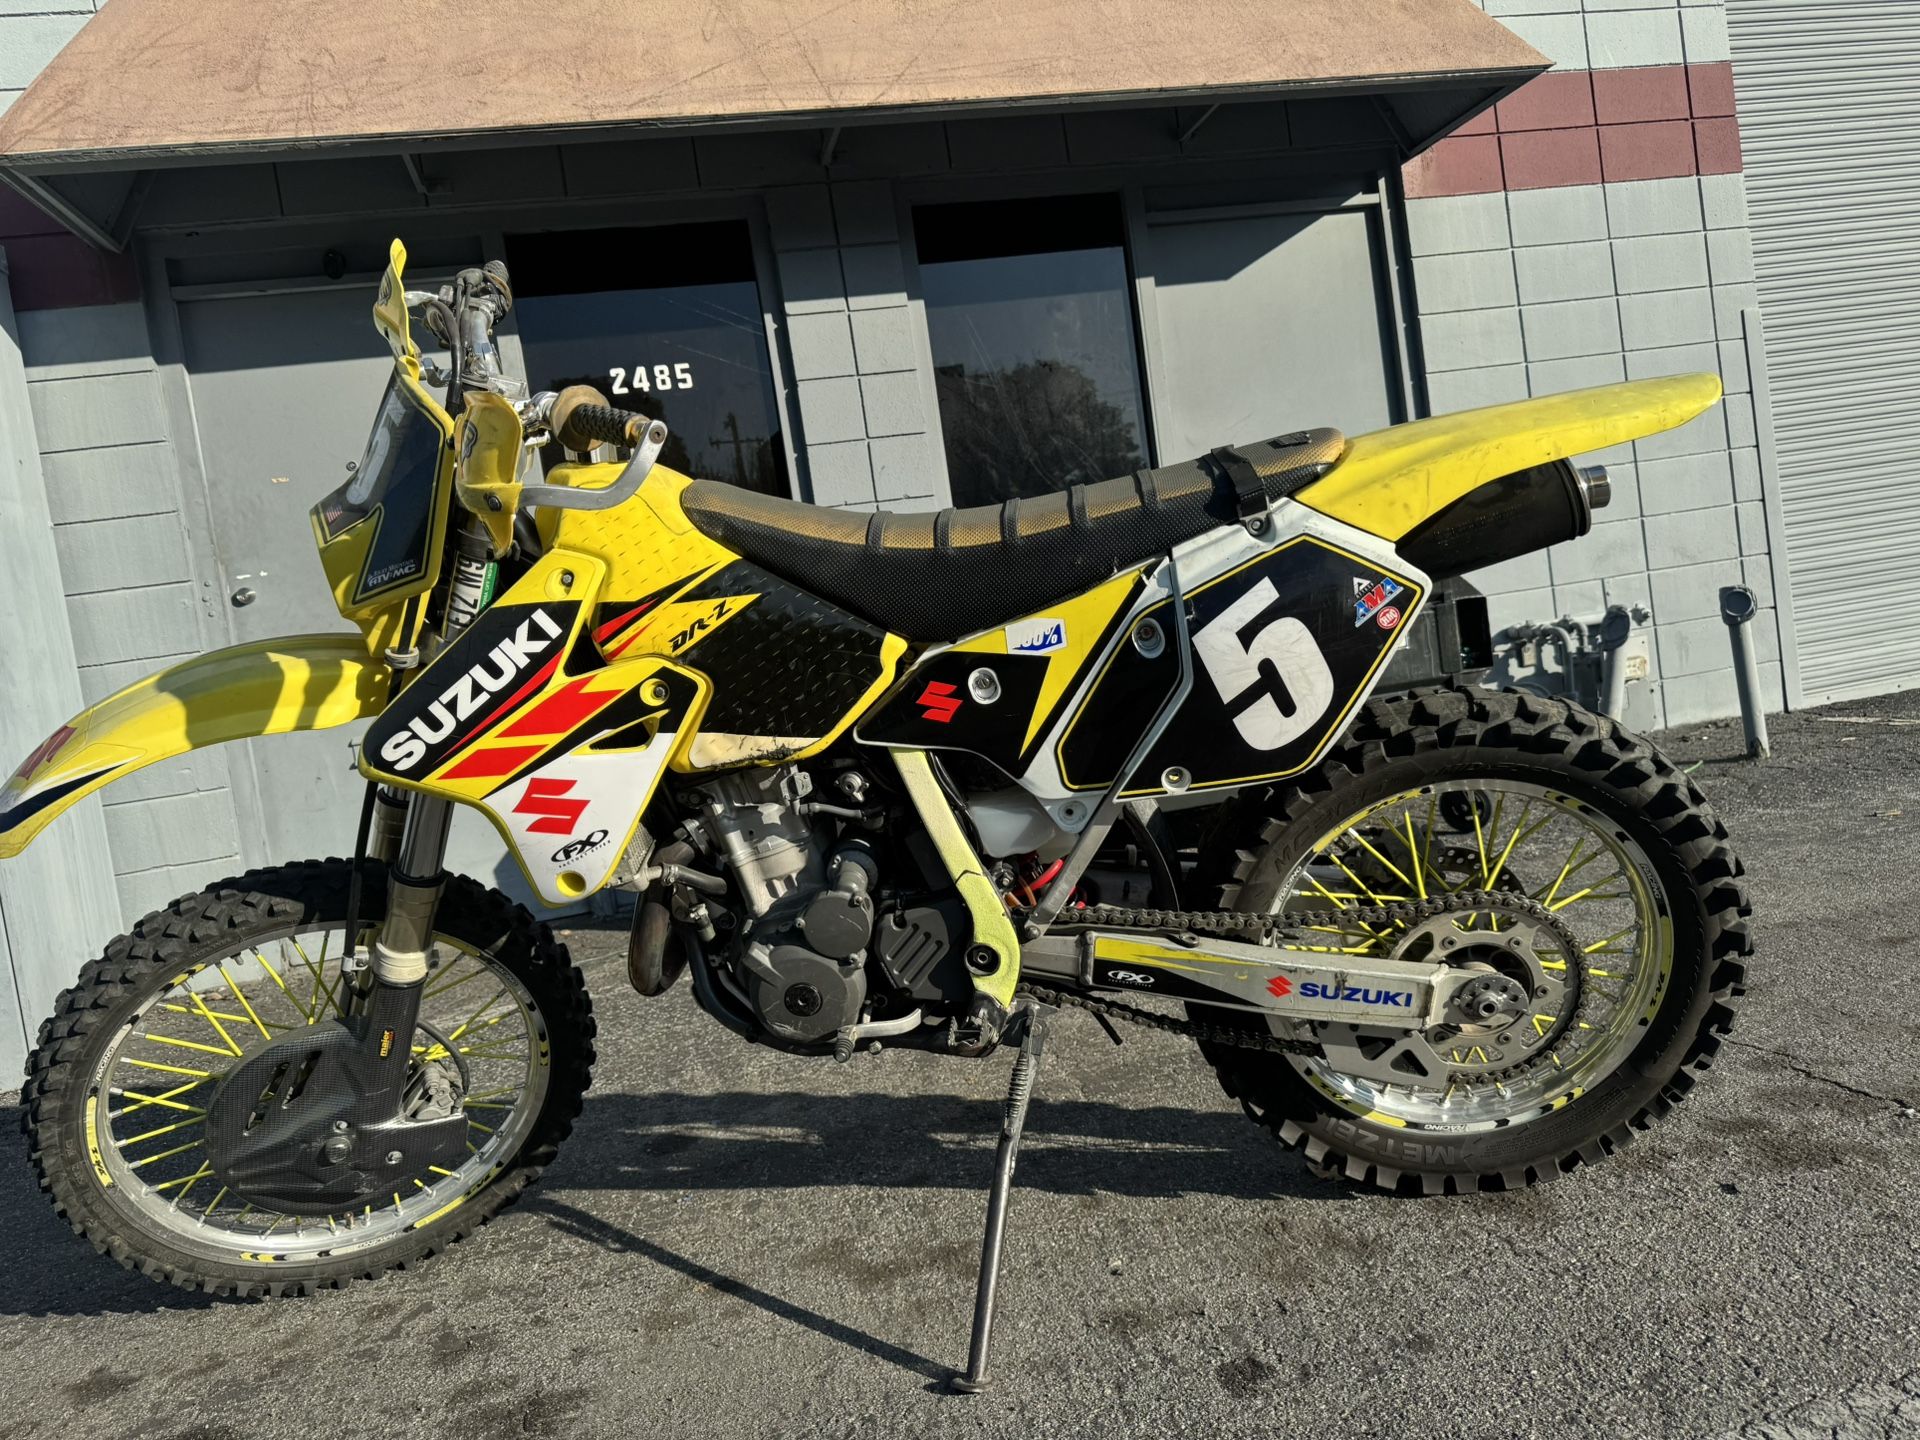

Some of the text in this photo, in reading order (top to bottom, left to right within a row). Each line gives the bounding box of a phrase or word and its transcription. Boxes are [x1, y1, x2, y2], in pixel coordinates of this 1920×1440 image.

[609, 362, 693, 395] 2485
[1353, 577, 1401, 623] AMA
[668, 600, 733, 653] DR-Z
[1192, 576, 1334, 750] 5
[381, 608, 563, 771] SUZUKI
[1277, 864, 1303, 901] RACING
[1299, 983, 1412, 1008] SUZUKI
[379, 1030, 391, 1057] maier
[94, 1045, 115, 1081] RACING
[1422, 1121, 1463, 1133] RACING
